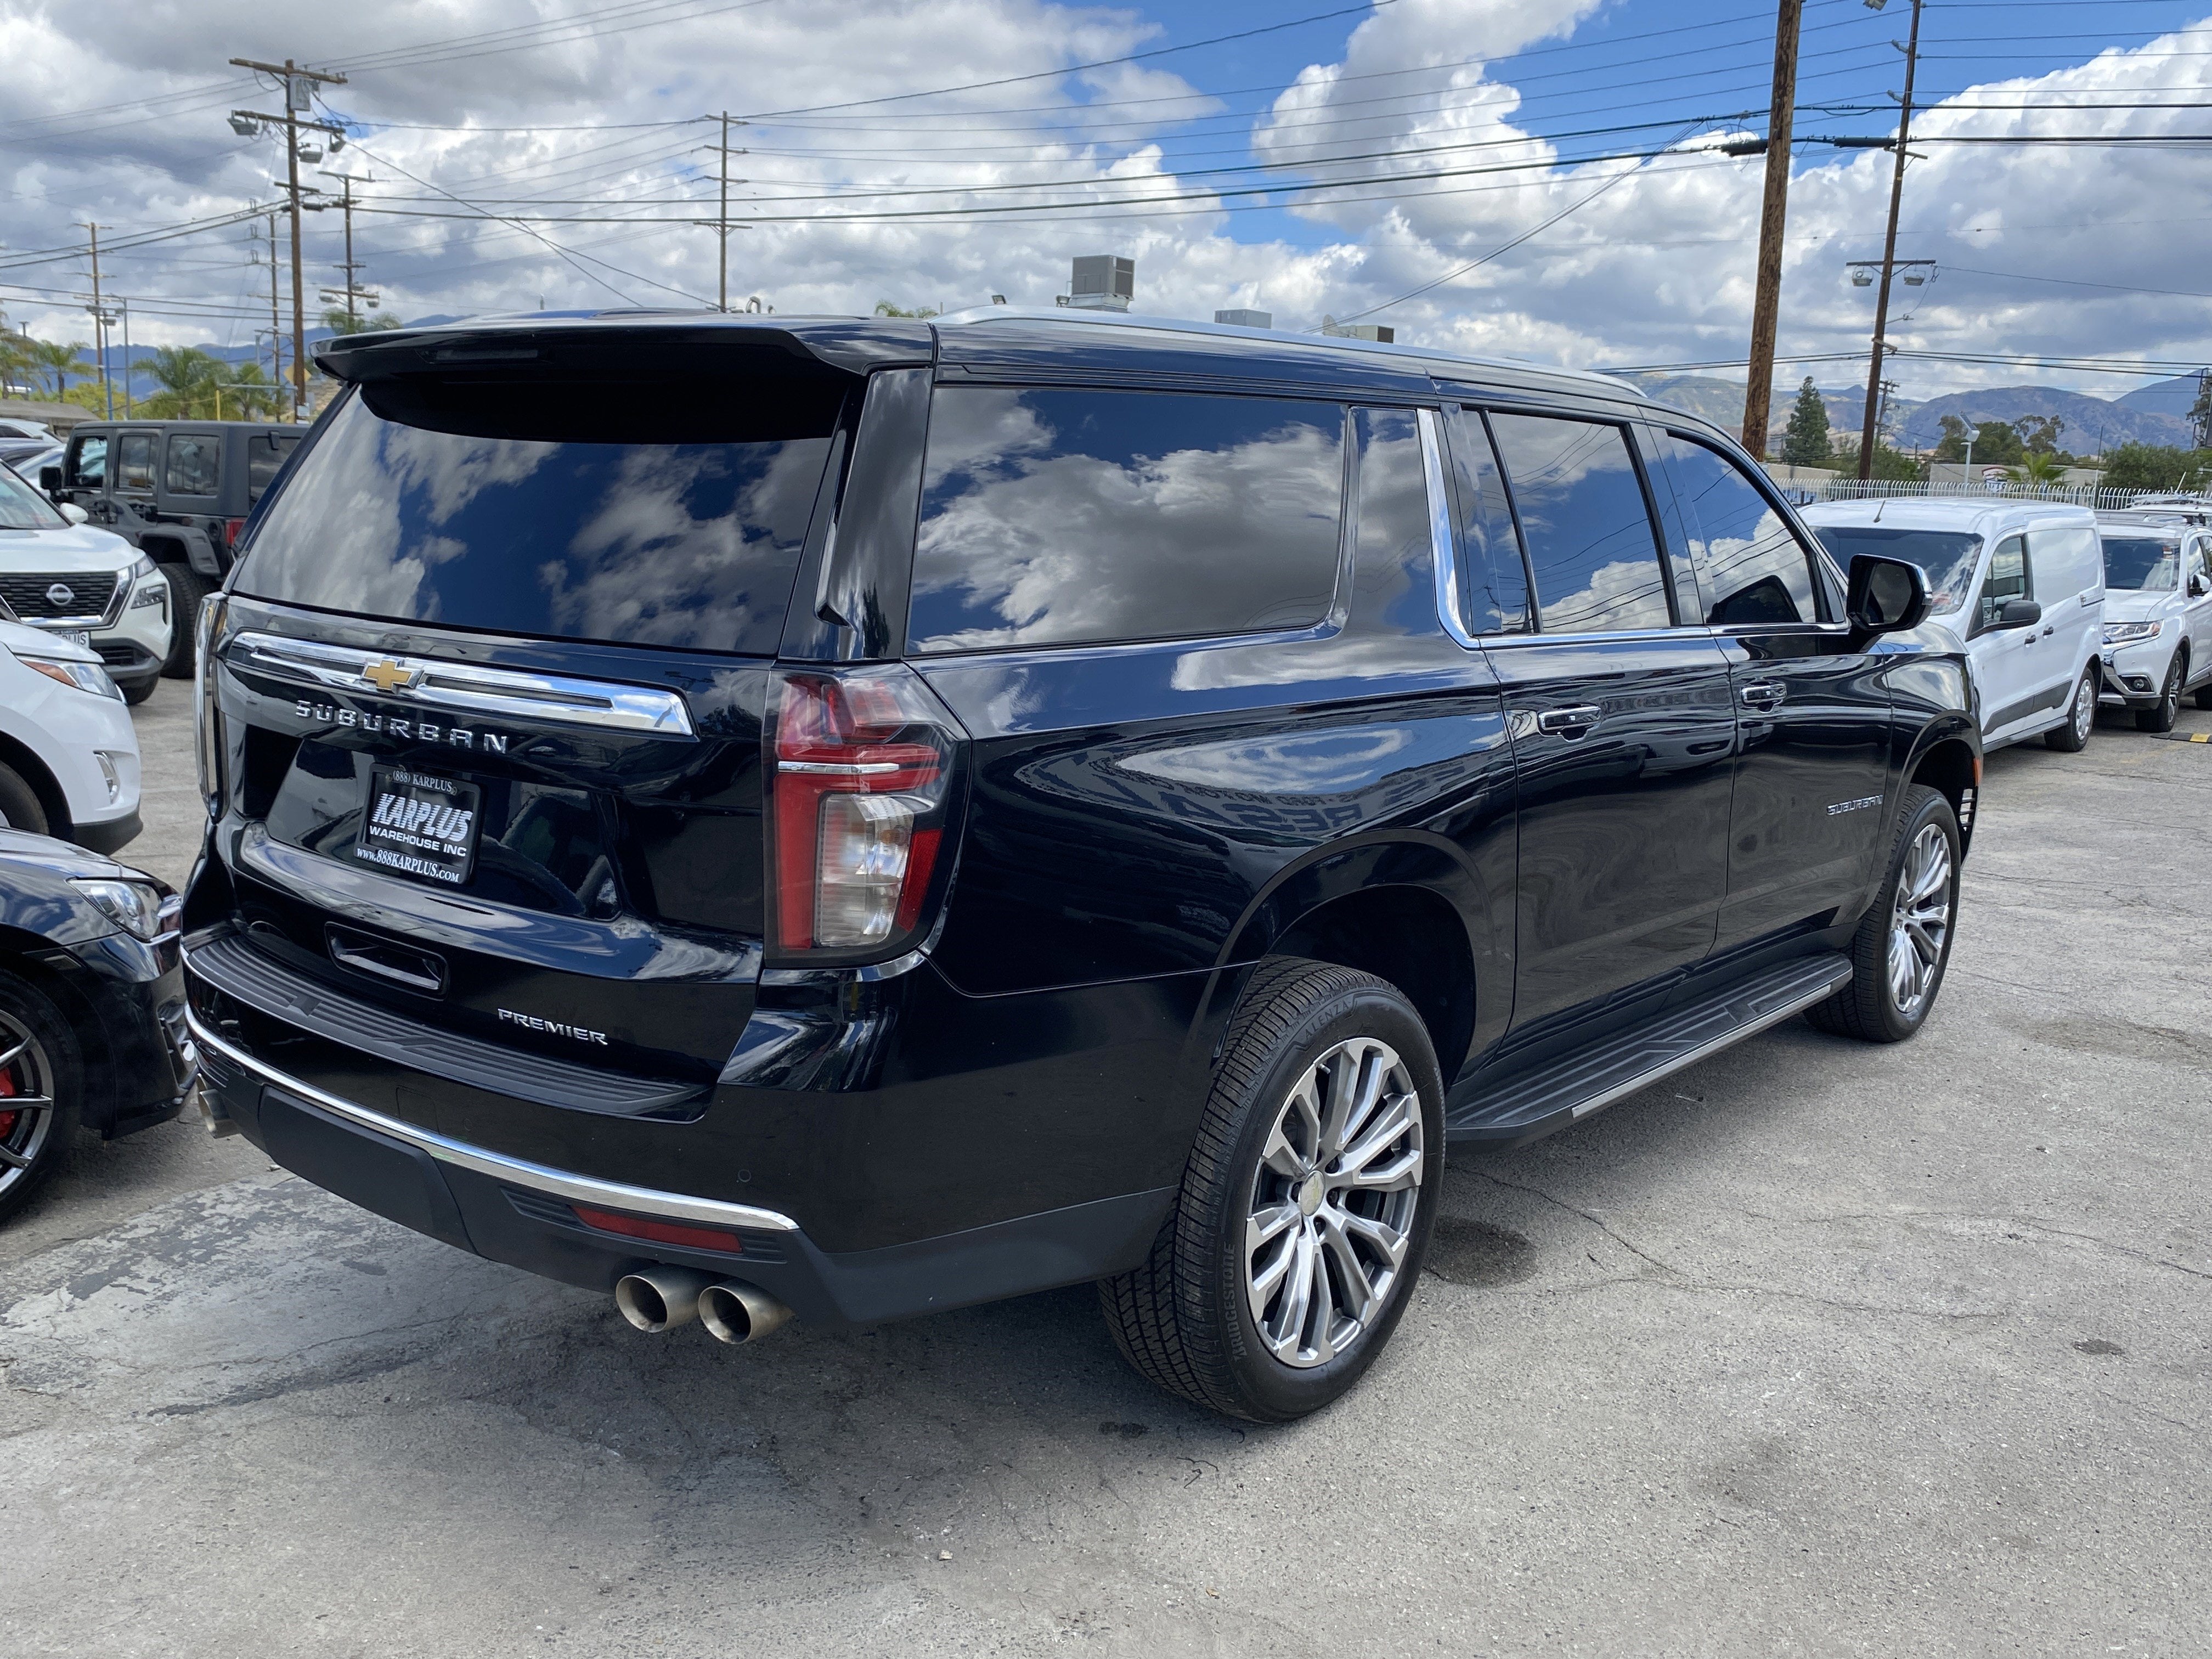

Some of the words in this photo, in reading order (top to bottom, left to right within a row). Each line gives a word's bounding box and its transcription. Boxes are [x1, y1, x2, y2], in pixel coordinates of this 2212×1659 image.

[296, 699, 509, 754] SUBURBAN
[393, 770, 411, 783] (888)
[413, 774, 453, 792] KARPLUS
[371, 793, 473, 842] KARPLUS
[1826, 794, 1883, 815] SUBURBAN
[370, 825, 440, 851] WAREHOUSE
[443, 843, 467, 857] INC
[498, 1008, 608, 1045] PREMIER
[1305, 1000, 1349, 1040] ALENZA
